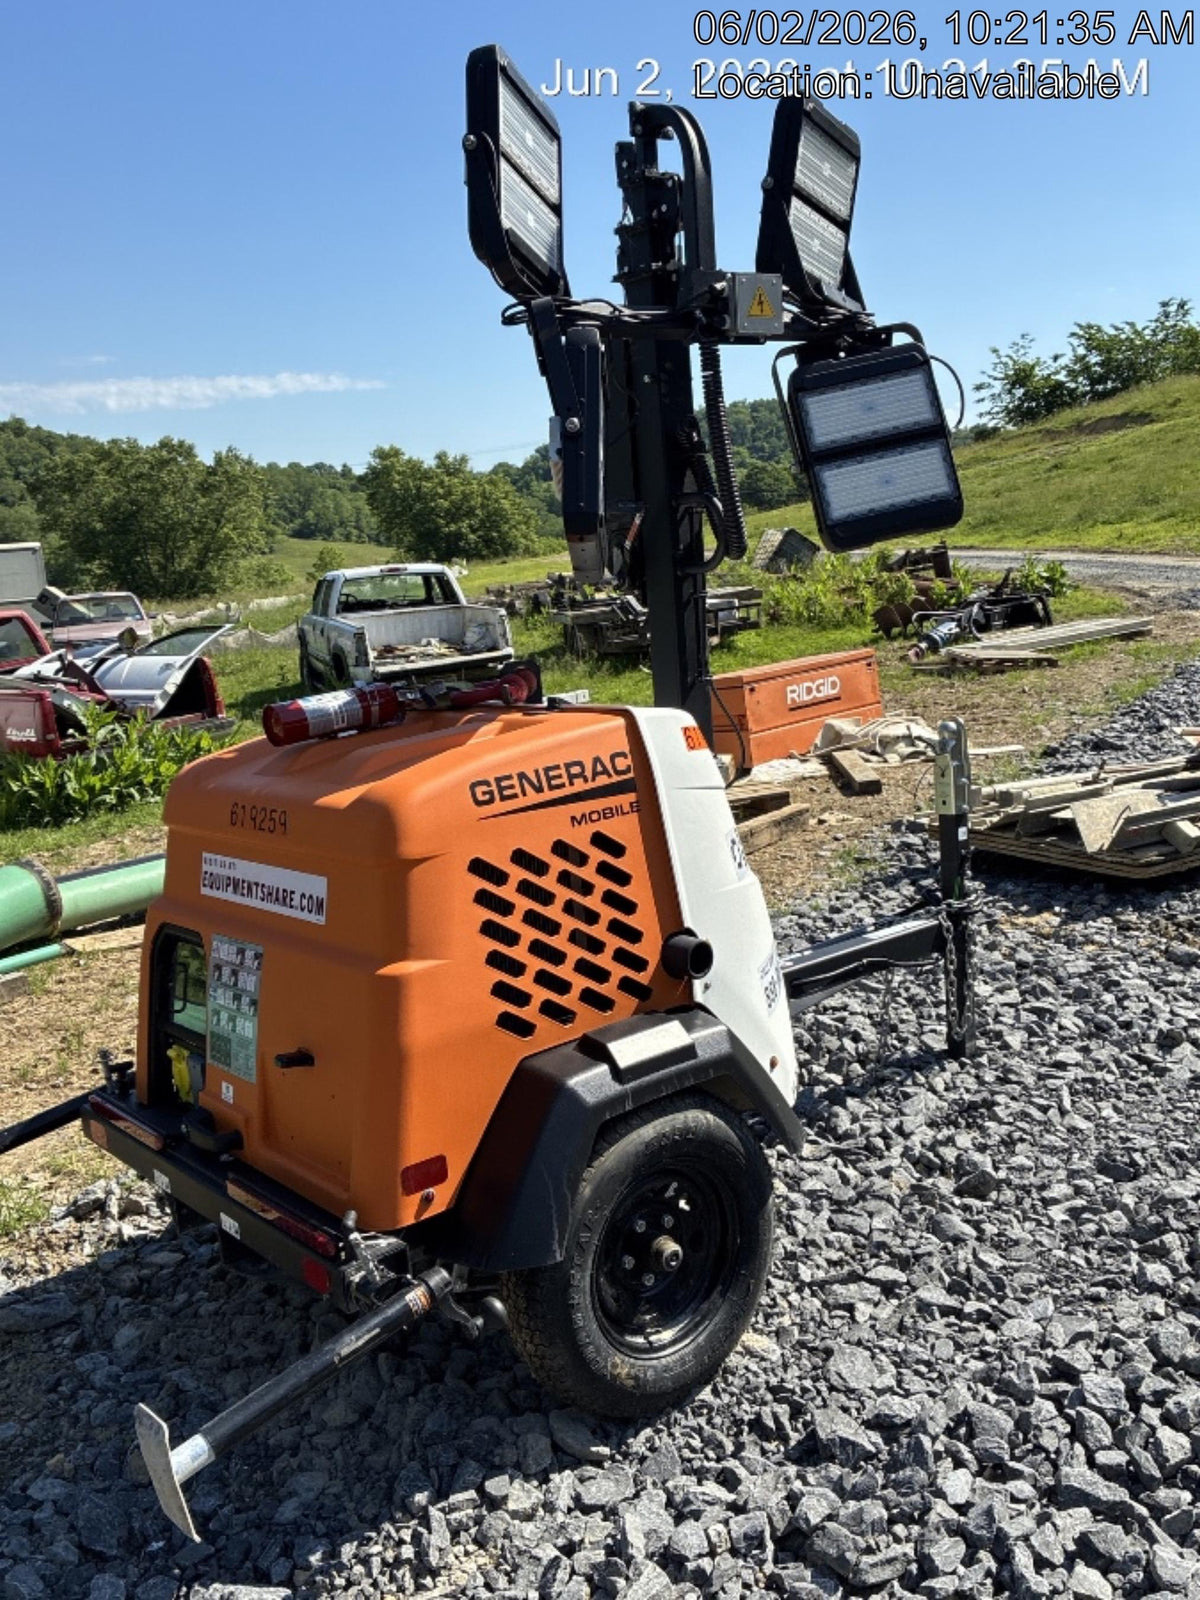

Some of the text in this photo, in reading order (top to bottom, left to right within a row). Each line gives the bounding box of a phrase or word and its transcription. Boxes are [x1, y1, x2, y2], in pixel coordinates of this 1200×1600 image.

[786, 675, 841, 706] RIDGID
[469, 751, 632, 807] GENERAC
[229, 802, 288, 835] 619259
[570, 801, 641, 828] MOBILE
[202, 870, 325, 918] EQUIPMENTSHARE.COM
